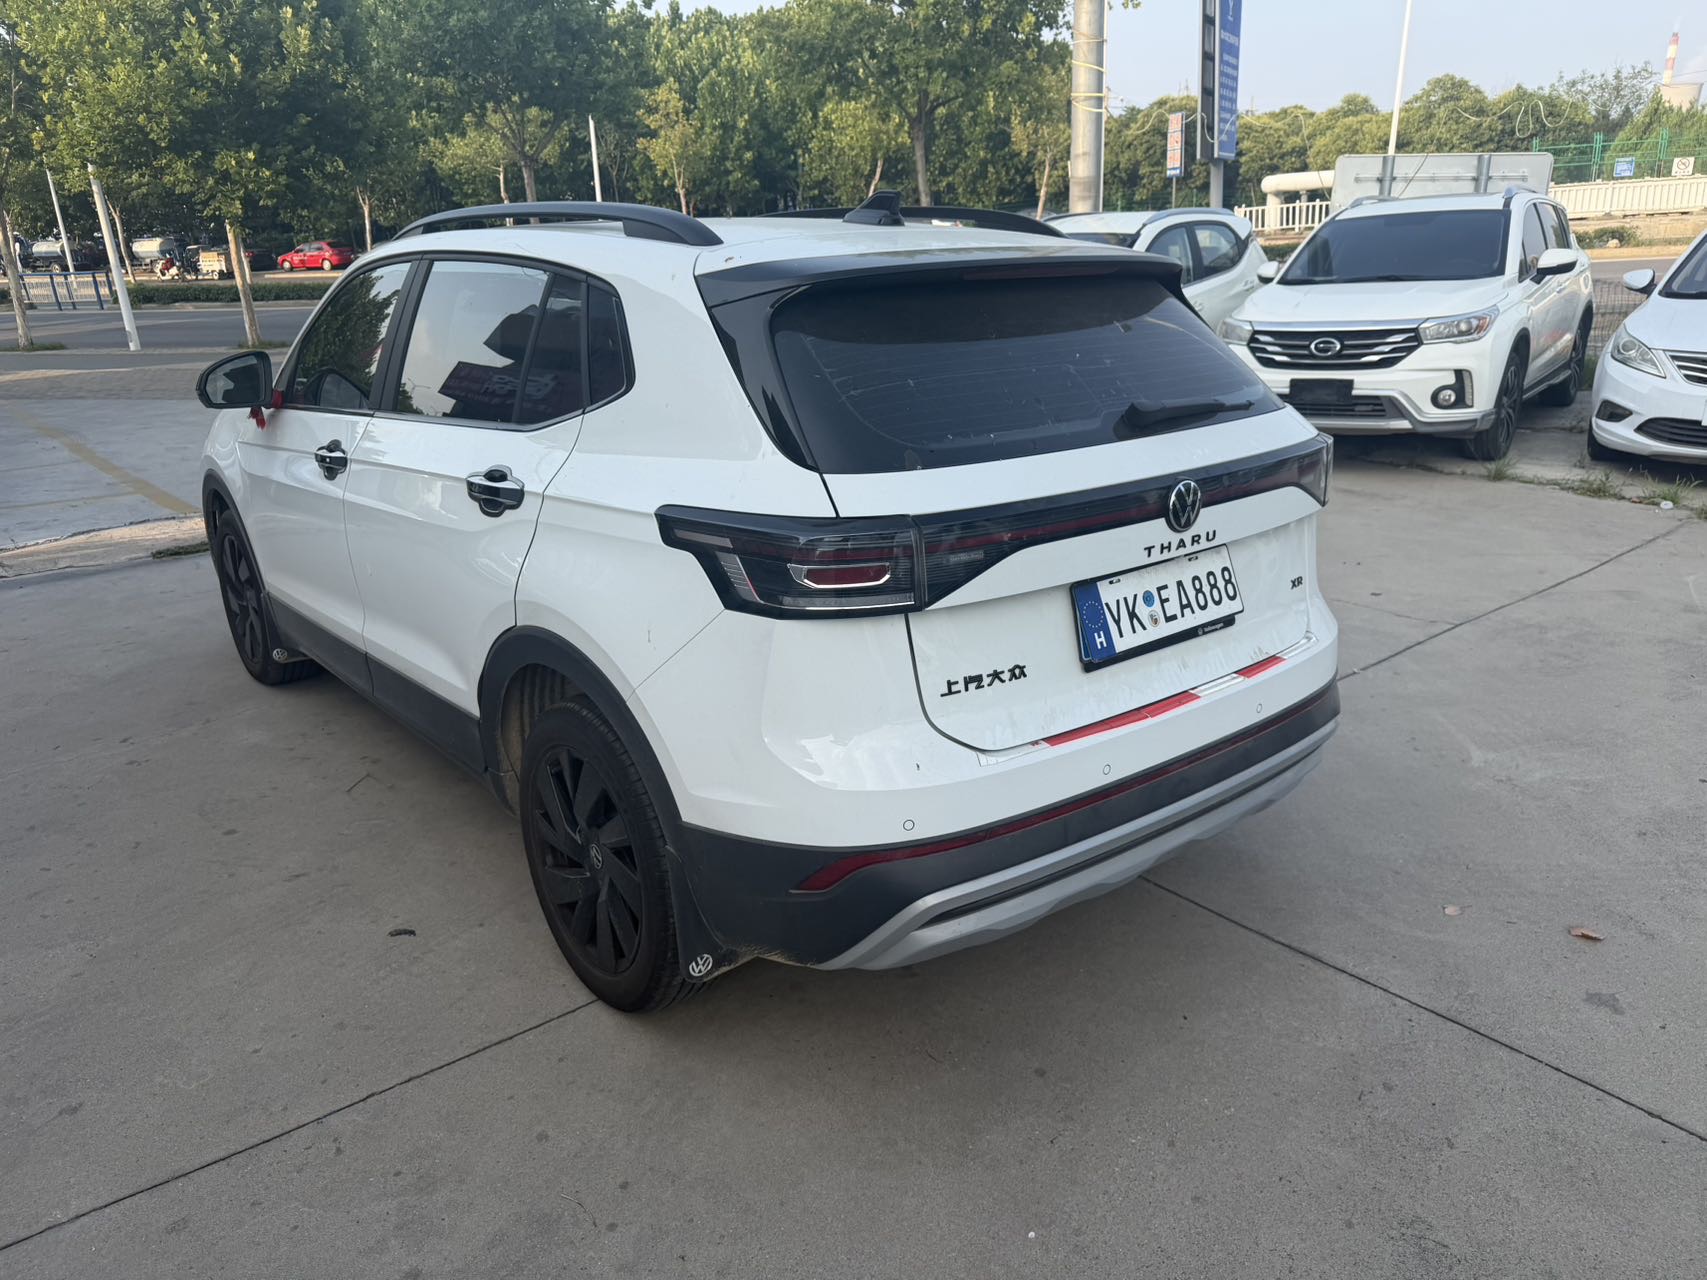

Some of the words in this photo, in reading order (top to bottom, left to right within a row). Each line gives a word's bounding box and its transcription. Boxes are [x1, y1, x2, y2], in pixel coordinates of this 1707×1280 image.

[1144, 530, 1217, 558] THARU
[1290, 576, 1304, 590] XR
[1104, 593, 1147, 638] YK
[1156, 566, 1238, 622] EA888
[1094, 631, 1108, 649] H
[940, 664, 1027, 697] 上汽大众
